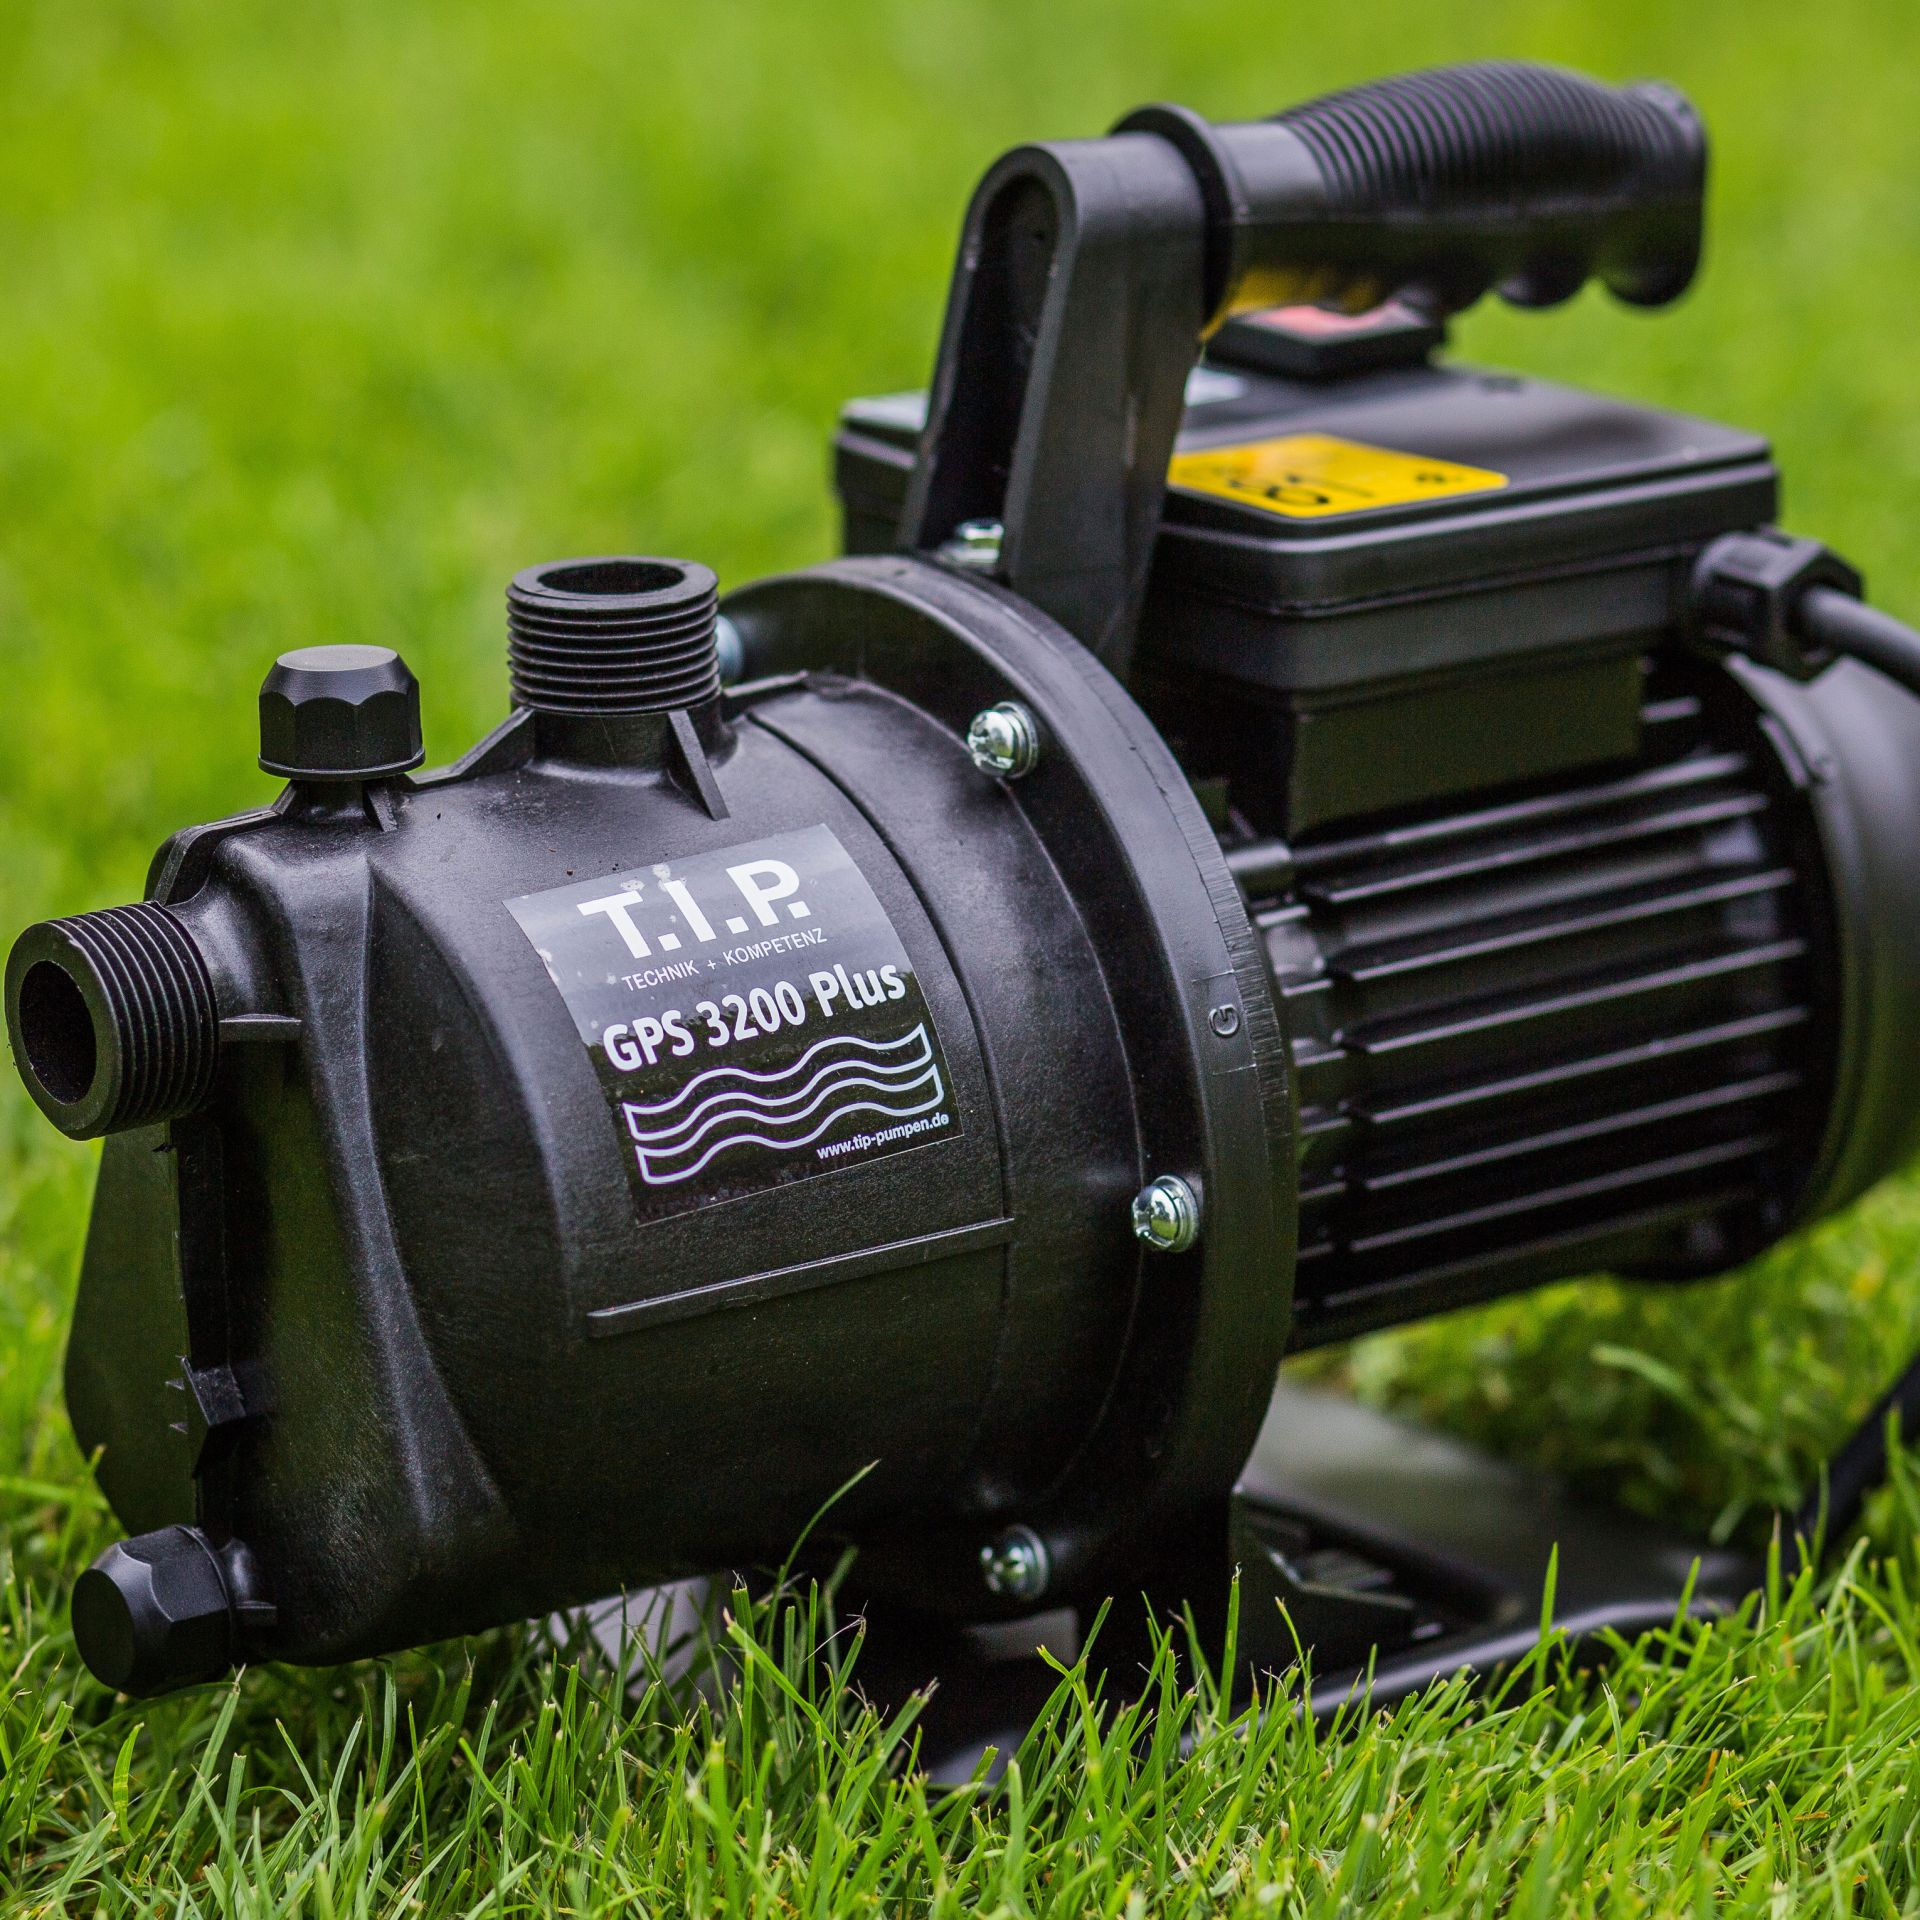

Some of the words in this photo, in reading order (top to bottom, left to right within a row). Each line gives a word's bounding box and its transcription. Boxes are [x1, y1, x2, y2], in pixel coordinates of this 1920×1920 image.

[578, 860, 811, 958] T.I.P.
[623, 960, 699, 991] TECHNIK
[722, 928, 827, 965] KOMPETENZ
[603, 1009, 695, 1071] GPS
[695, 980, 806, 1046] 3200
[808, 963, 906, 1017] Plus
[816, 1111, 949, 1159] www.tip-pumpen.de
